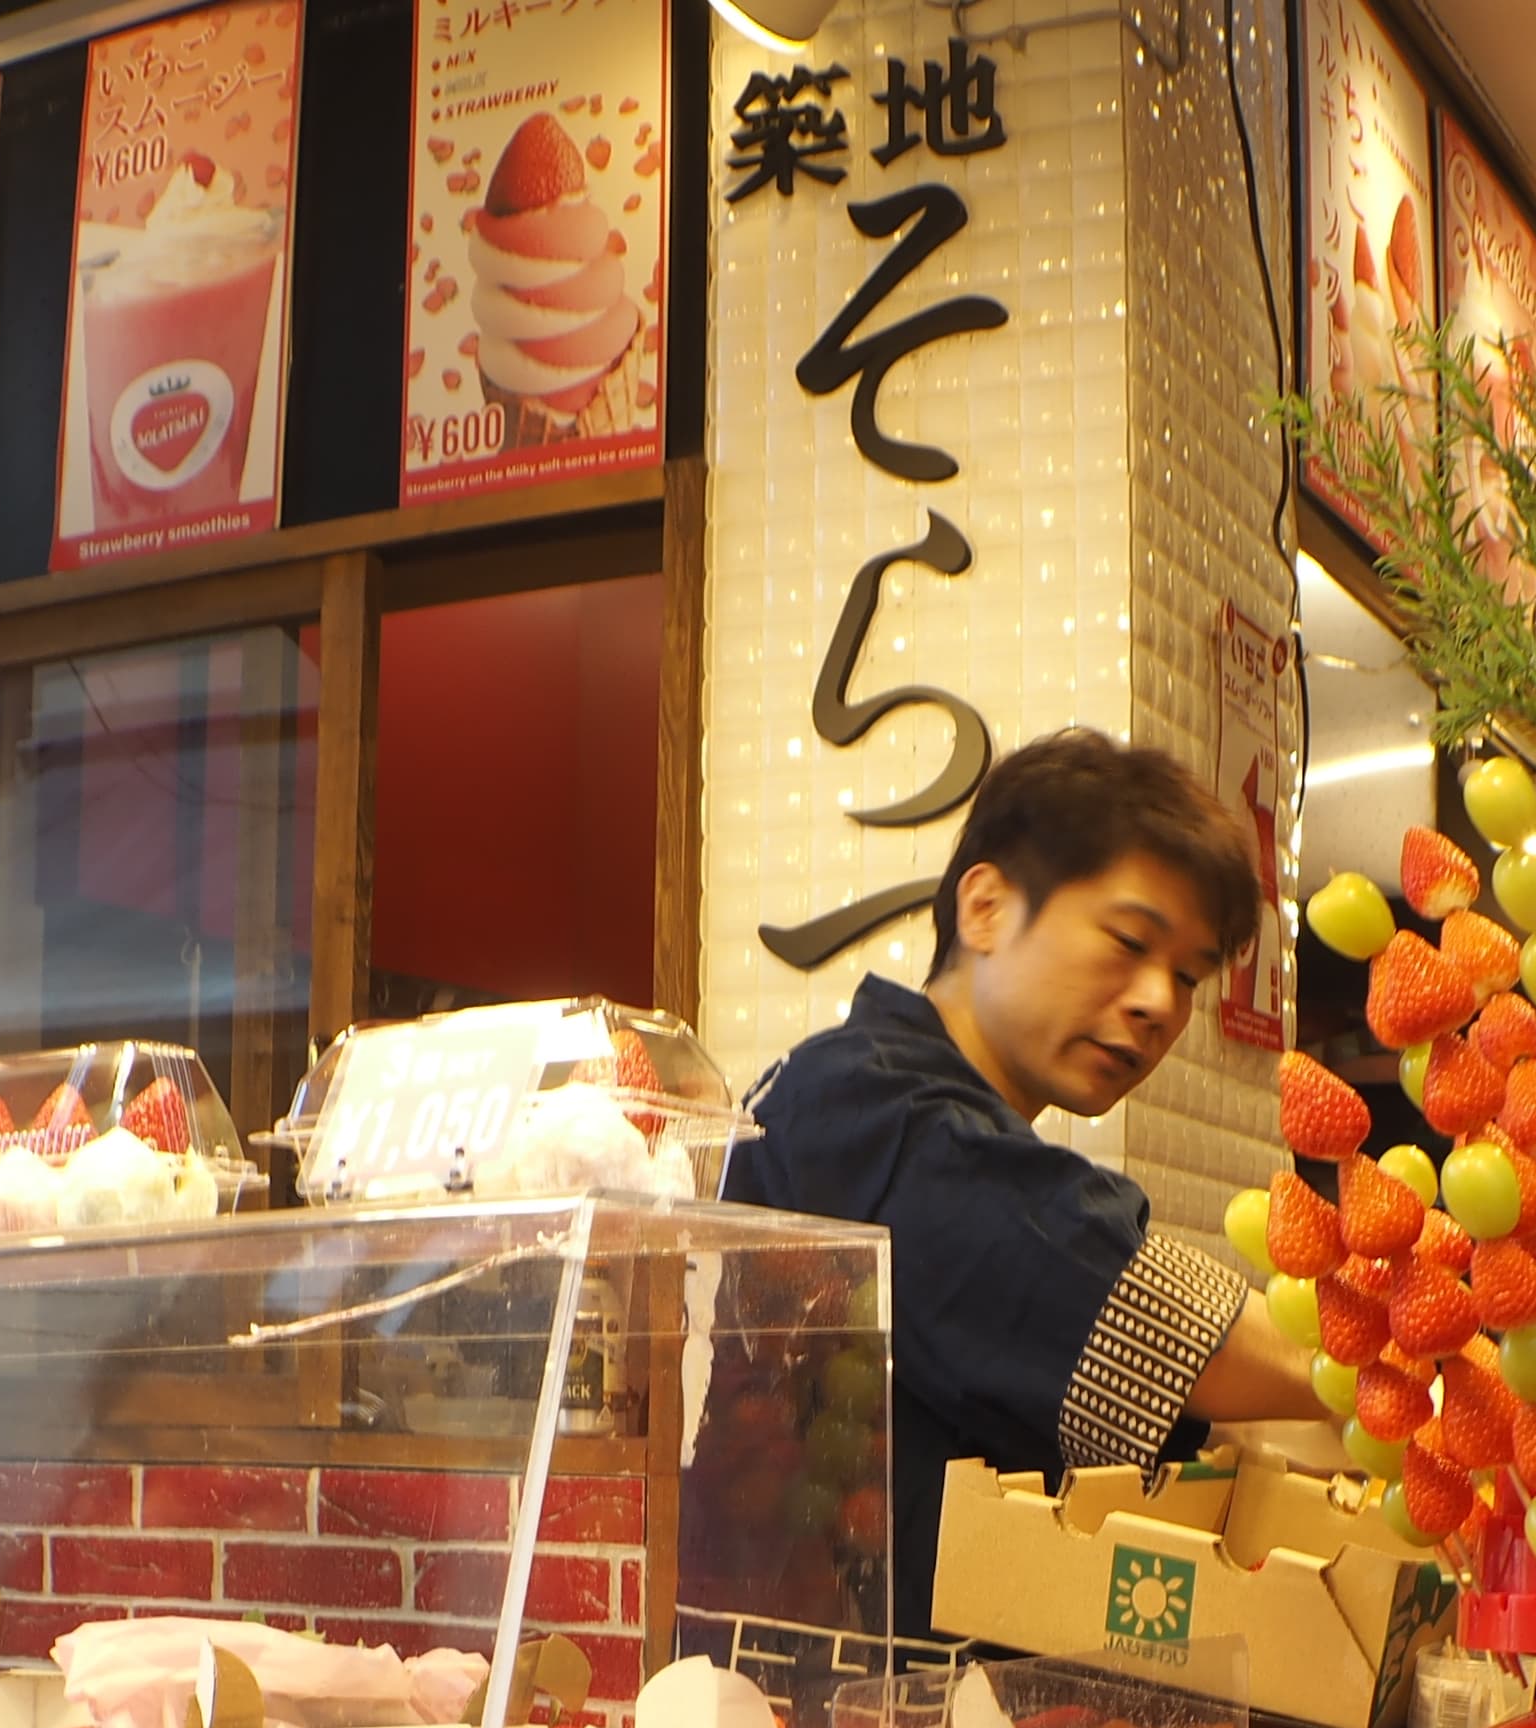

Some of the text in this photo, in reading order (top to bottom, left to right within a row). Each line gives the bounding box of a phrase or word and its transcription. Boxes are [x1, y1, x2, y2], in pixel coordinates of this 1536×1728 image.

[99, 27, 216, 97] いちご
[95, 65, 284, 145] スムージー
[445, 79, 559, 118] STRAWBERRY
[727, 37, 1006, 205] 築地
[94, 136, 167, 188] ¥600
[415, 405, 503, 462] ¥600
[407, 477, 465, 497] Strawberry
[469, 473, 483, 484] on
[485, 467, 504, 483] the
[506, 462, 536, 481] Milky
[618, 444, 656, 461] cream
[79, 512, 250, 559] Strawberry smoothies
